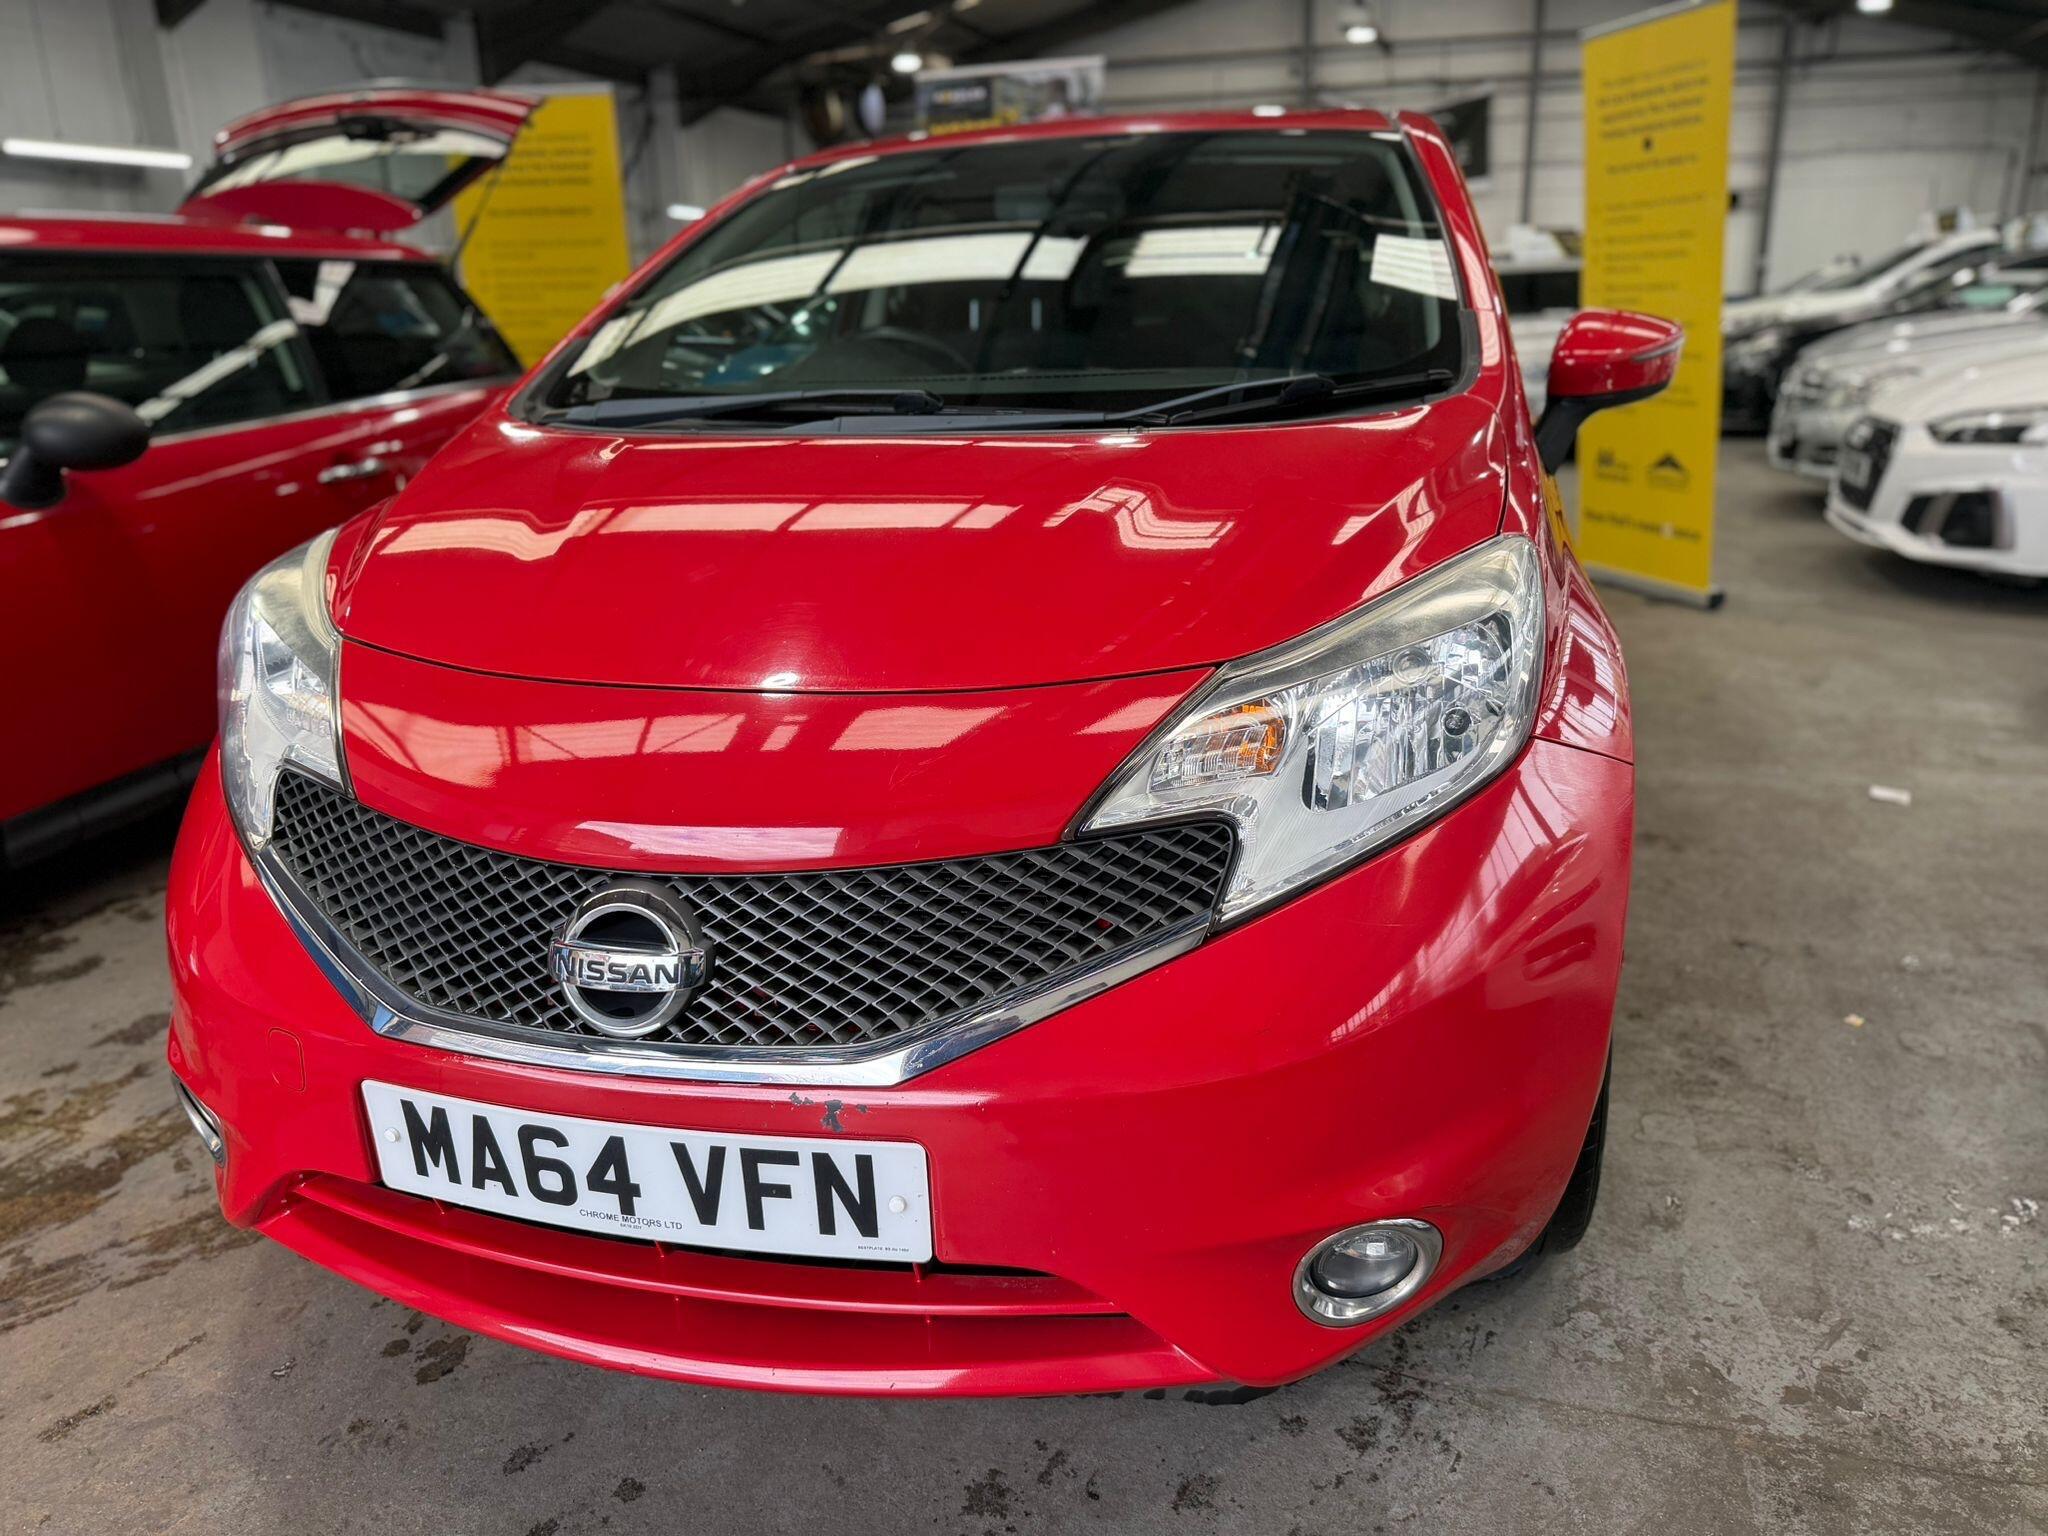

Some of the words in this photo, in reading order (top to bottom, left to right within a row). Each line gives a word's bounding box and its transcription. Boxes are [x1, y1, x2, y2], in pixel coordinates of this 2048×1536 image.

[556, 954, 679, 985] NISSAN
[400, 1099, 641, 1216] MA64
[670, 1141, 879, 1238] VFN
[579, 1209, 619, 1221] CHROME
[621, 1215, 662, 1228] MOTORS
[664, 1220, 683, 1230] LTD
